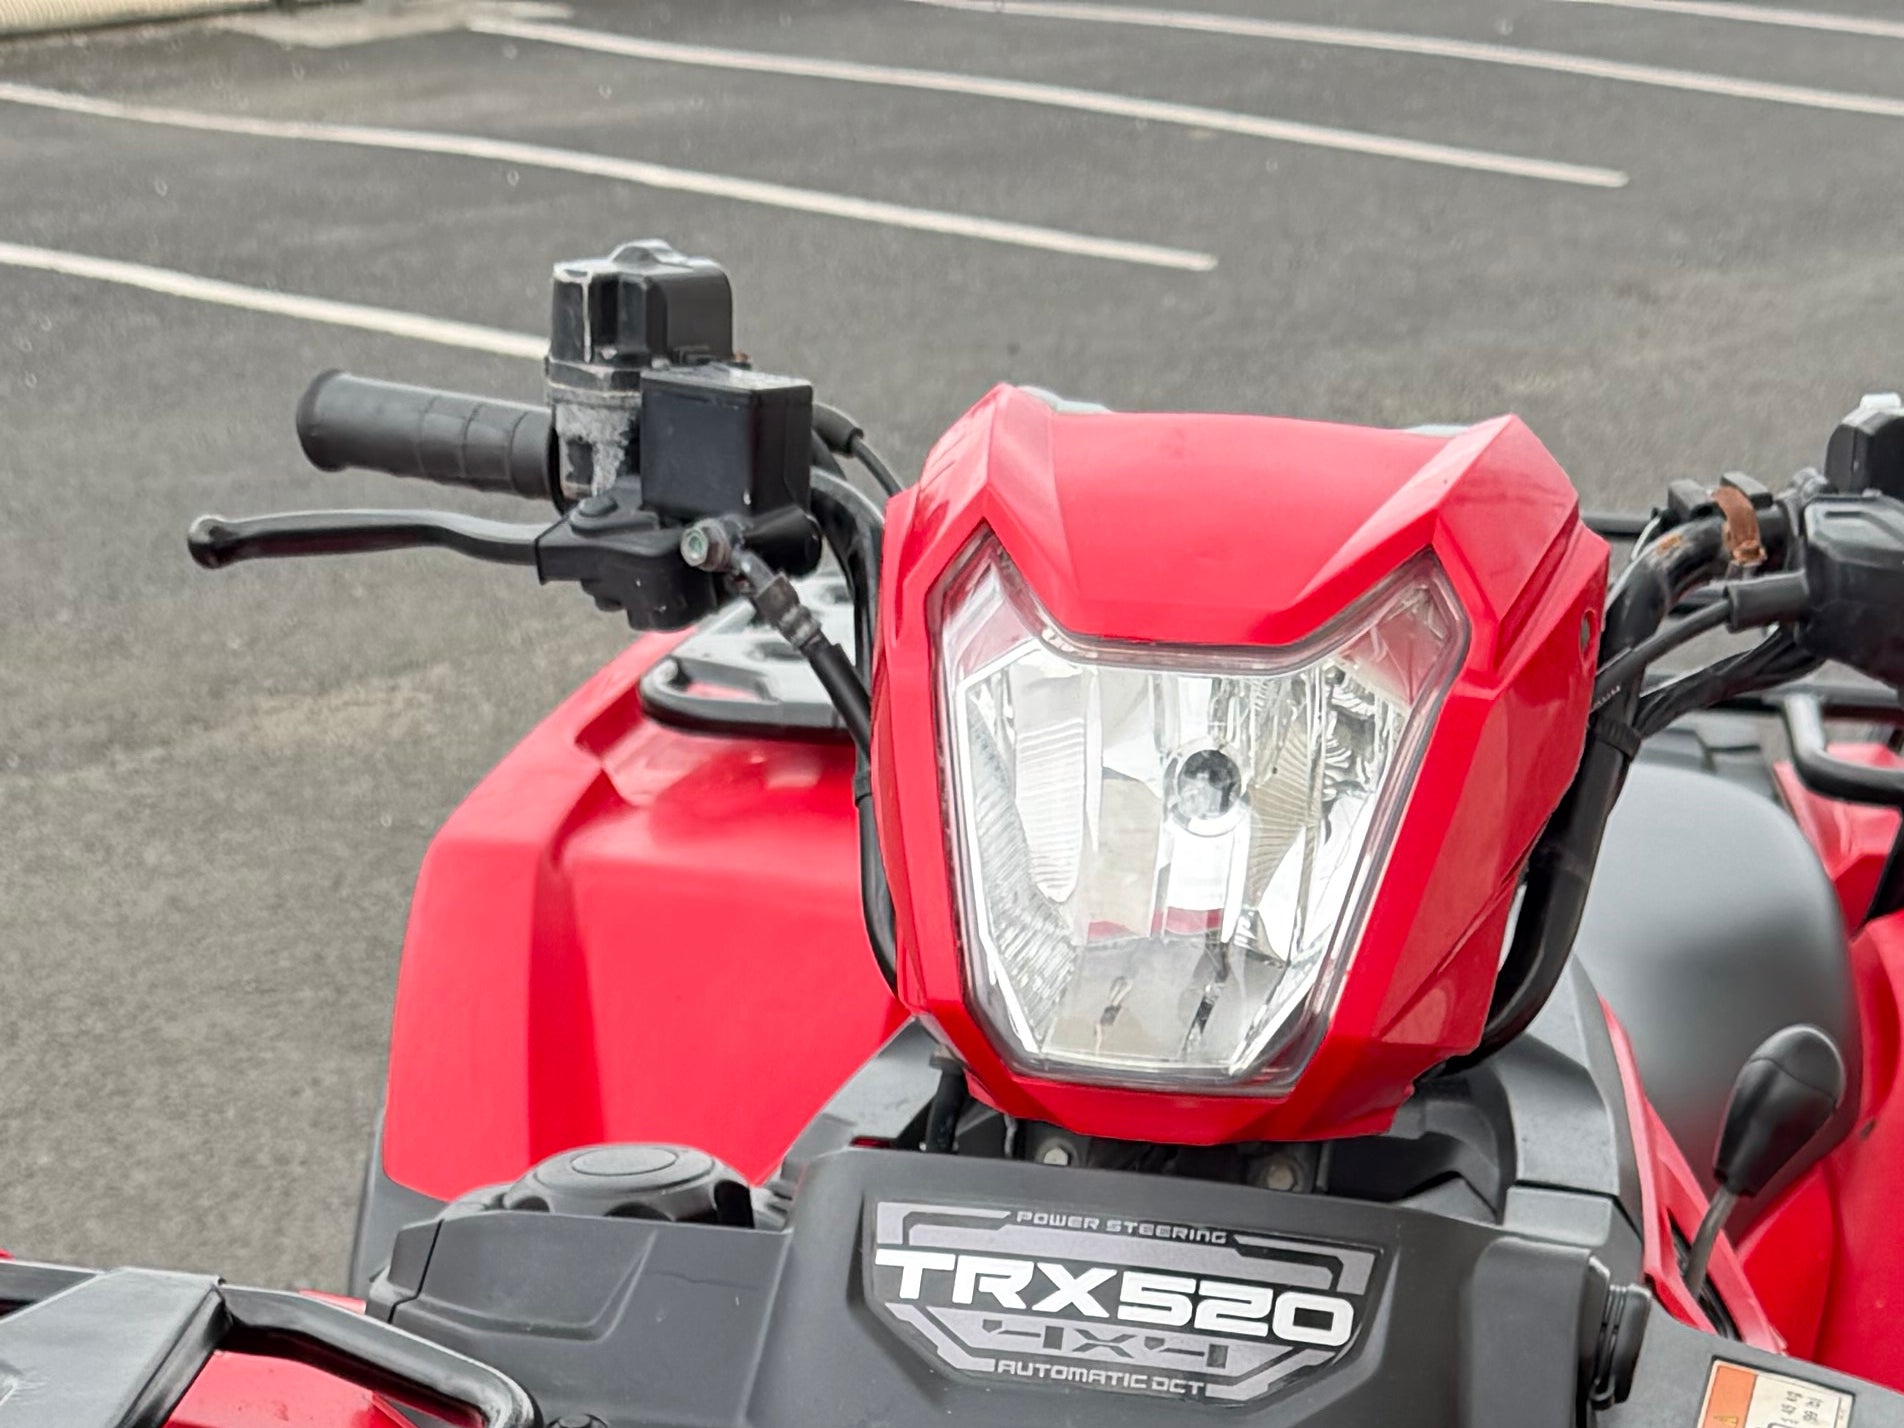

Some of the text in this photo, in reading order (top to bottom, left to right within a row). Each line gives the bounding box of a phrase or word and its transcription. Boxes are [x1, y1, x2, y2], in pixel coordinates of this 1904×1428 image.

[1016, 1210, 1228, 1245] POWER STEERING
[874, 1248, 1355, 1347] TRX520
[997, 1359, 1205, 1397] AUTOMATIC DCT
